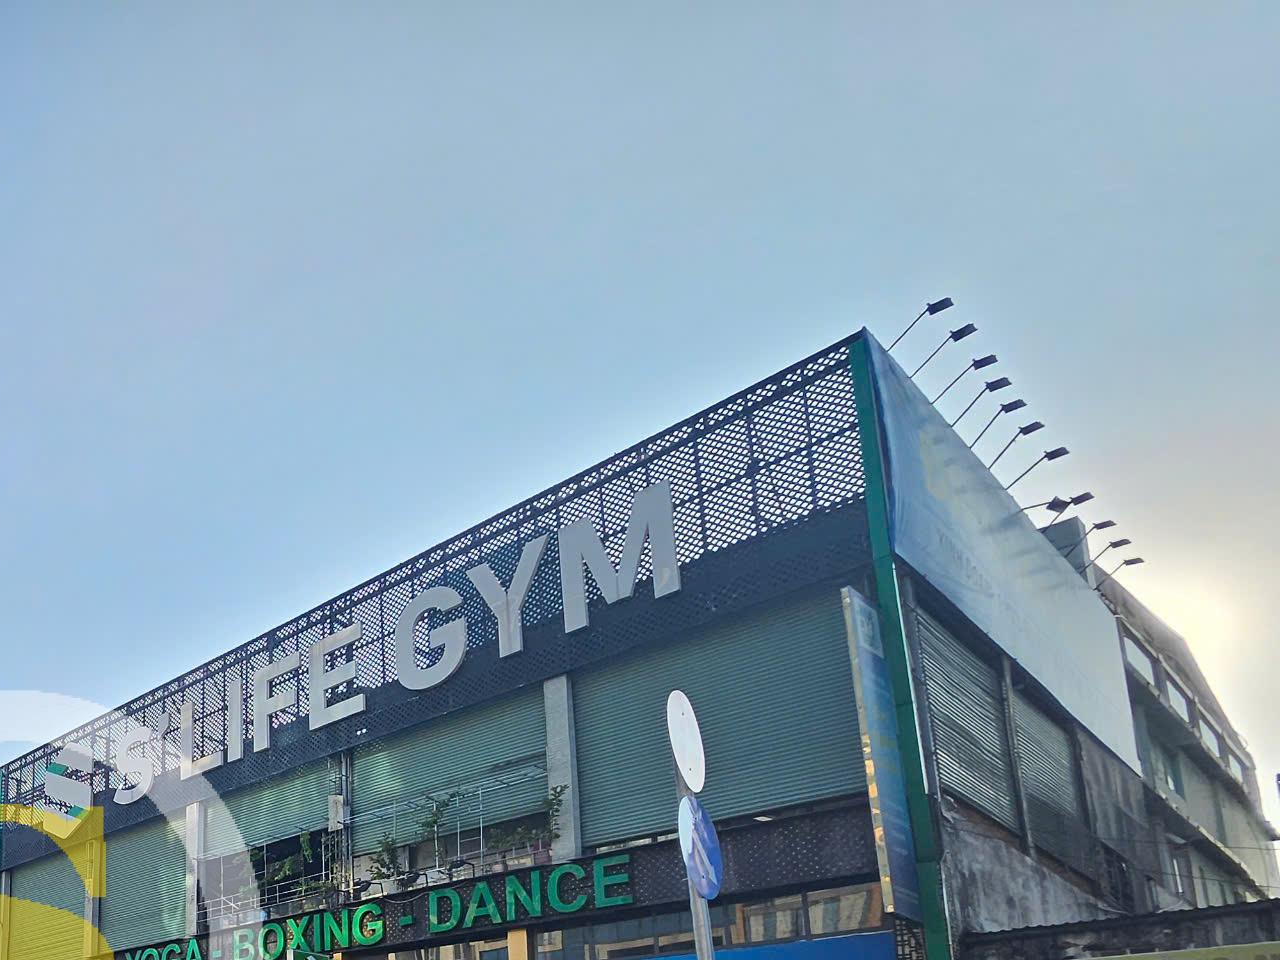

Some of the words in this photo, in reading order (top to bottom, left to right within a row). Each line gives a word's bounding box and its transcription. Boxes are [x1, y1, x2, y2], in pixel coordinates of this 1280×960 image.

[113, 620, 365, 804] S'LIFE
[394, 480, 681, 691] GYM
[429, 854, 634, 934] DANCE
